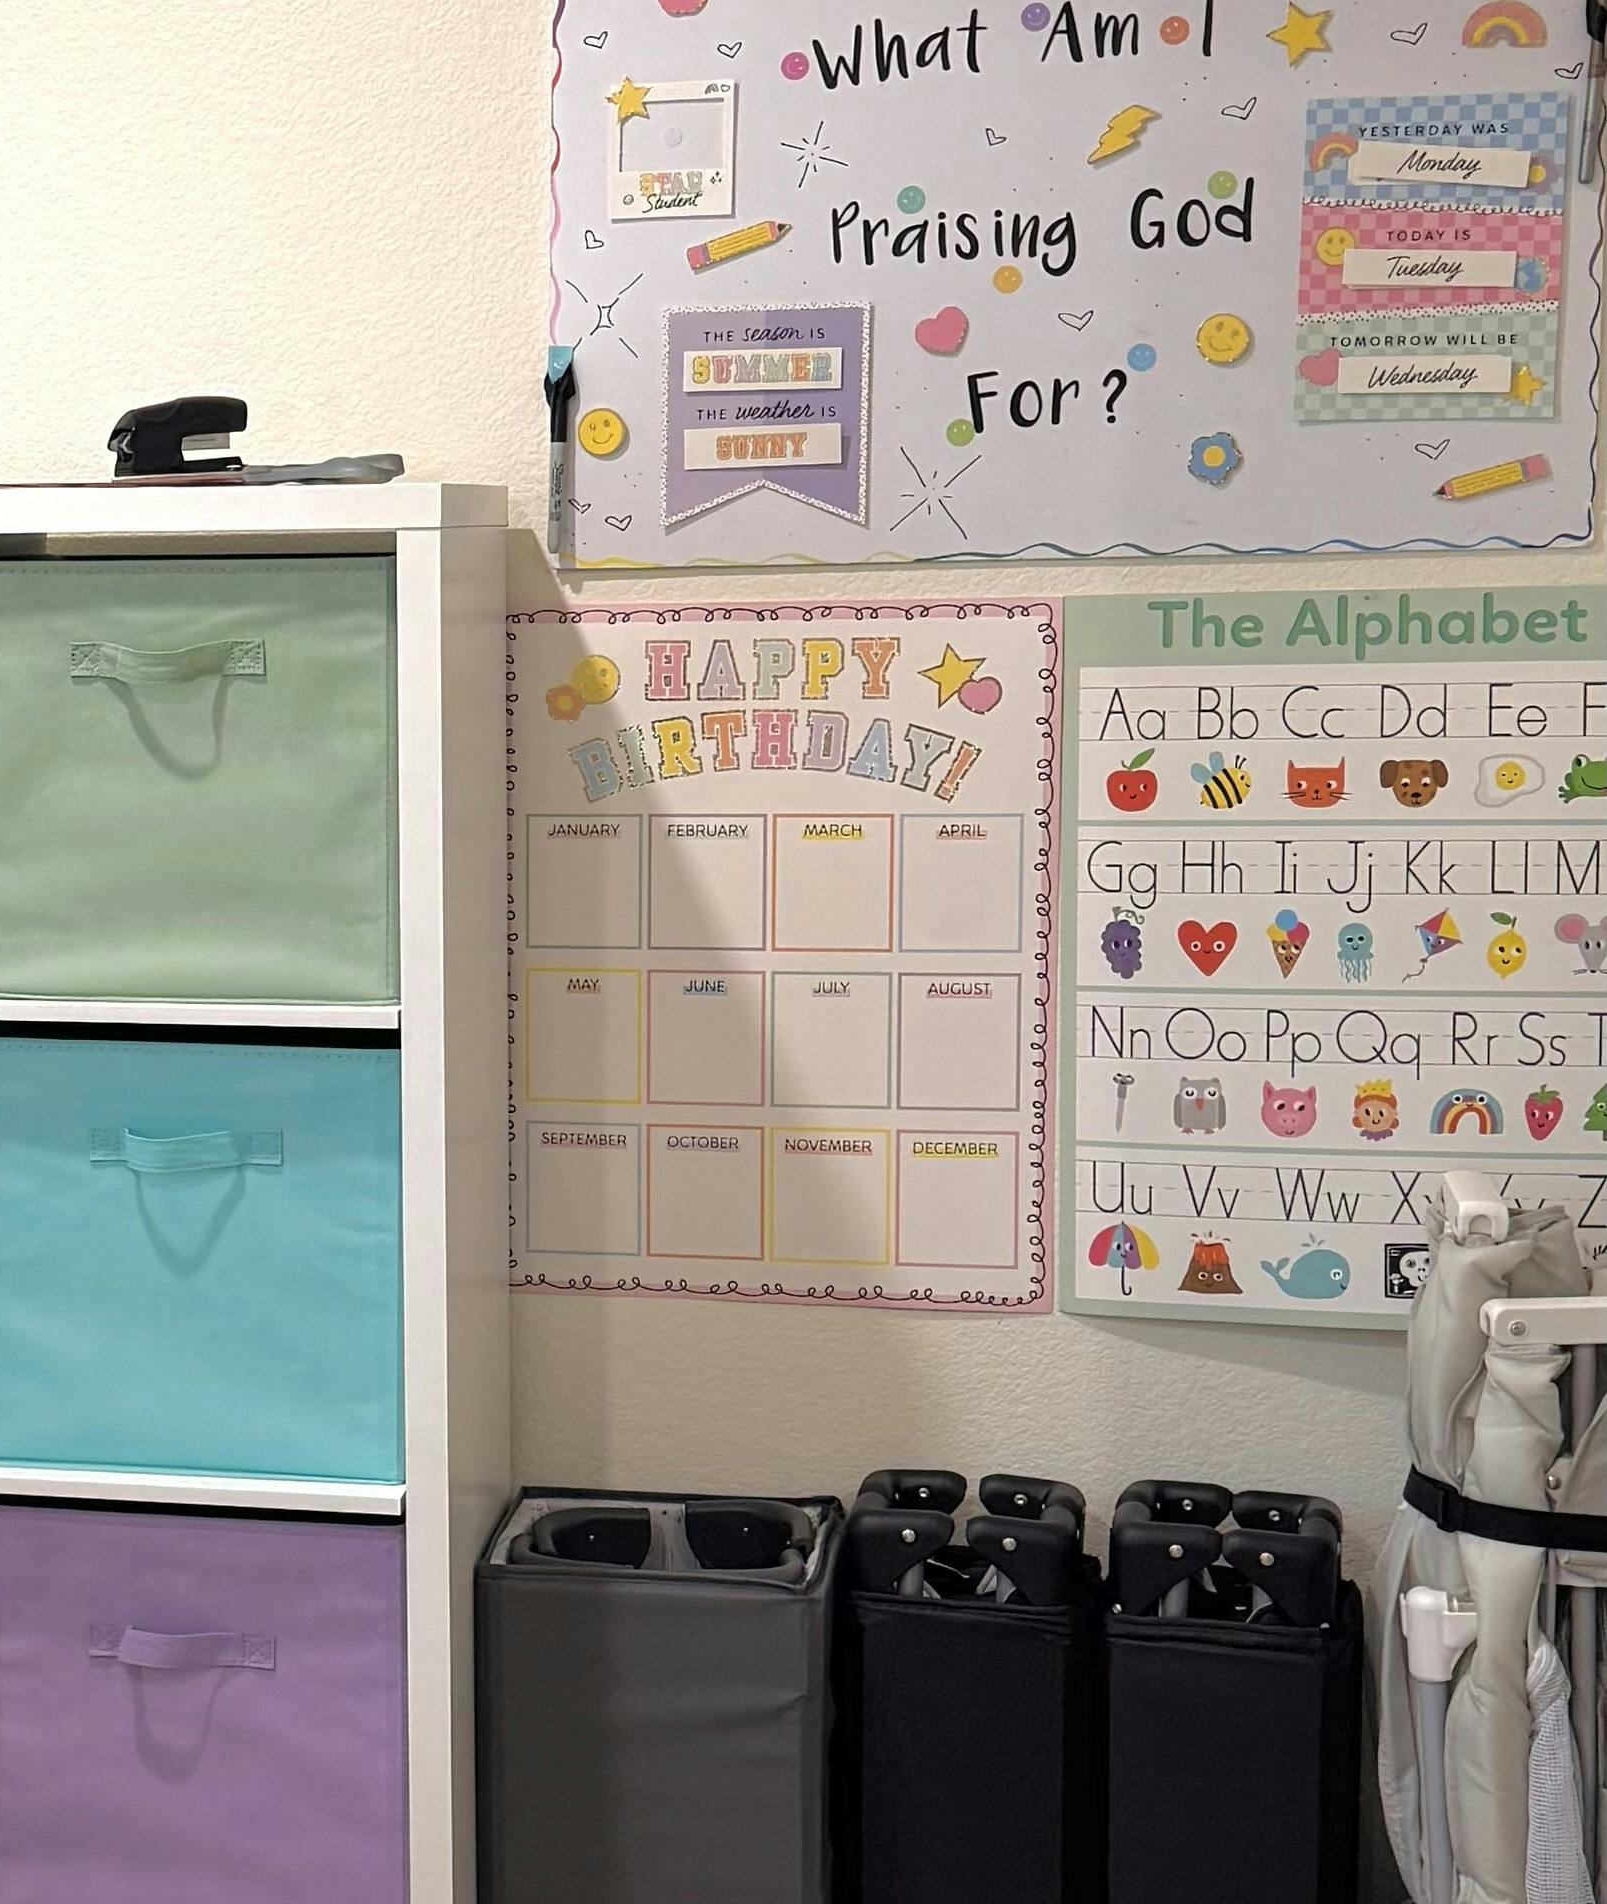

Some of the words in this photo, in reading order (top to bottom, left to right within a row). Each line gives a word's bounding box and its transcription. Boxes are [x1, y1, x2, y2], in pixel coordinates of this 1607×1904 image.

[812, 8, 988, 91] What
[1041, 0, 1139, 64] Am
[1358, 122, 1463, 138] YESTERDAY
[1471, 121, 1510, 136] WAS
[1397, 149, 1483, 178] Monday
[642, 192, 704, 213] Student
[831, 200, 1078, 278] Praising
[1130, 177, 1255, 250] God
[1386, 229, 1447, 244] TODAY
[1453, 228, 1472, 242] IS
[1387, 254, 1465, 283] Tuesday
[703, 330, 735, 344] THE
[742, 326, 805, 343] season
[809, 327, 826, 340] IS
[1330, 333, 1440, 348] TOMORROW
[1446, 333, 1489, 347] WILL
[1498, 332, 1519, 345] BE
[691, 352, 833, 385] SUMMER
[1367, 361, 1479, 389] Wednesday
[697, 408, 727, 421] THE
[735, 399, 817, 420] weather
[820, 404, 837, 418] IS
[715, 432, 808, 461] SUNNY
[1147, 597, 1265, 649] The
[1286, 592, 1589, 661] Alphabet
[645, 637, 901, 702] HAPPY
[1099, 687, 1167, 741] Aa
[1197, 686, 1260, 741] Bb
[1281, 684, 1346, 739] Cc
[1379, 683, 1448, 738] Dd
[1487, 682, 1548, 738] Ee
[568, 708, 983, 804] BIRTHDAY!
[548, 824, 622, 838] JANUARY
[667, 824, 749, 838] FEBRUARY
[803, 824, 863, 838] MARCH
[938, 824, 987, 838] APRIL
[1086, 840, 1158, 909] Gg
[1180, 840, 1243, 894] Hh
[1274, 840, 1299, 895] Ii
[1327, 840, 1375, 914] Jj
[1405, 840, 1459, 895] Kk
[567, 979, 600, 993] MAY
[684, 979, 726, 994] JUNE
[813, 981, 851, 996] JULY
[927, 982, 992, 997] AUGUST
[1091, 1005, 1152, 1060] Nn
[1165, 1007, 1247, 1062] Oo
[1265, 1009, 1323, 1078] Pp
[1336, 1009, 1422, 1081] Qq
[1452, 1011, 1498, 1066] Rr
[1517, 1011, 1567, 1067] Ss
[541, 1132, 627, 1147] SEPTEMBER
[667, 1135, 739, 1150] OCTOBER
[784, 1139, 873, 1154] NOVEMBER
[912, 1141, 999, 1156] DECEMBER
[1093, 1160, 1153, 1215] Uu
[1182, 1164, 1240, 1219] Vv
[1275, 1169, 1361, 1223] Ww
[1391, 1170, 1432, 1225] X
